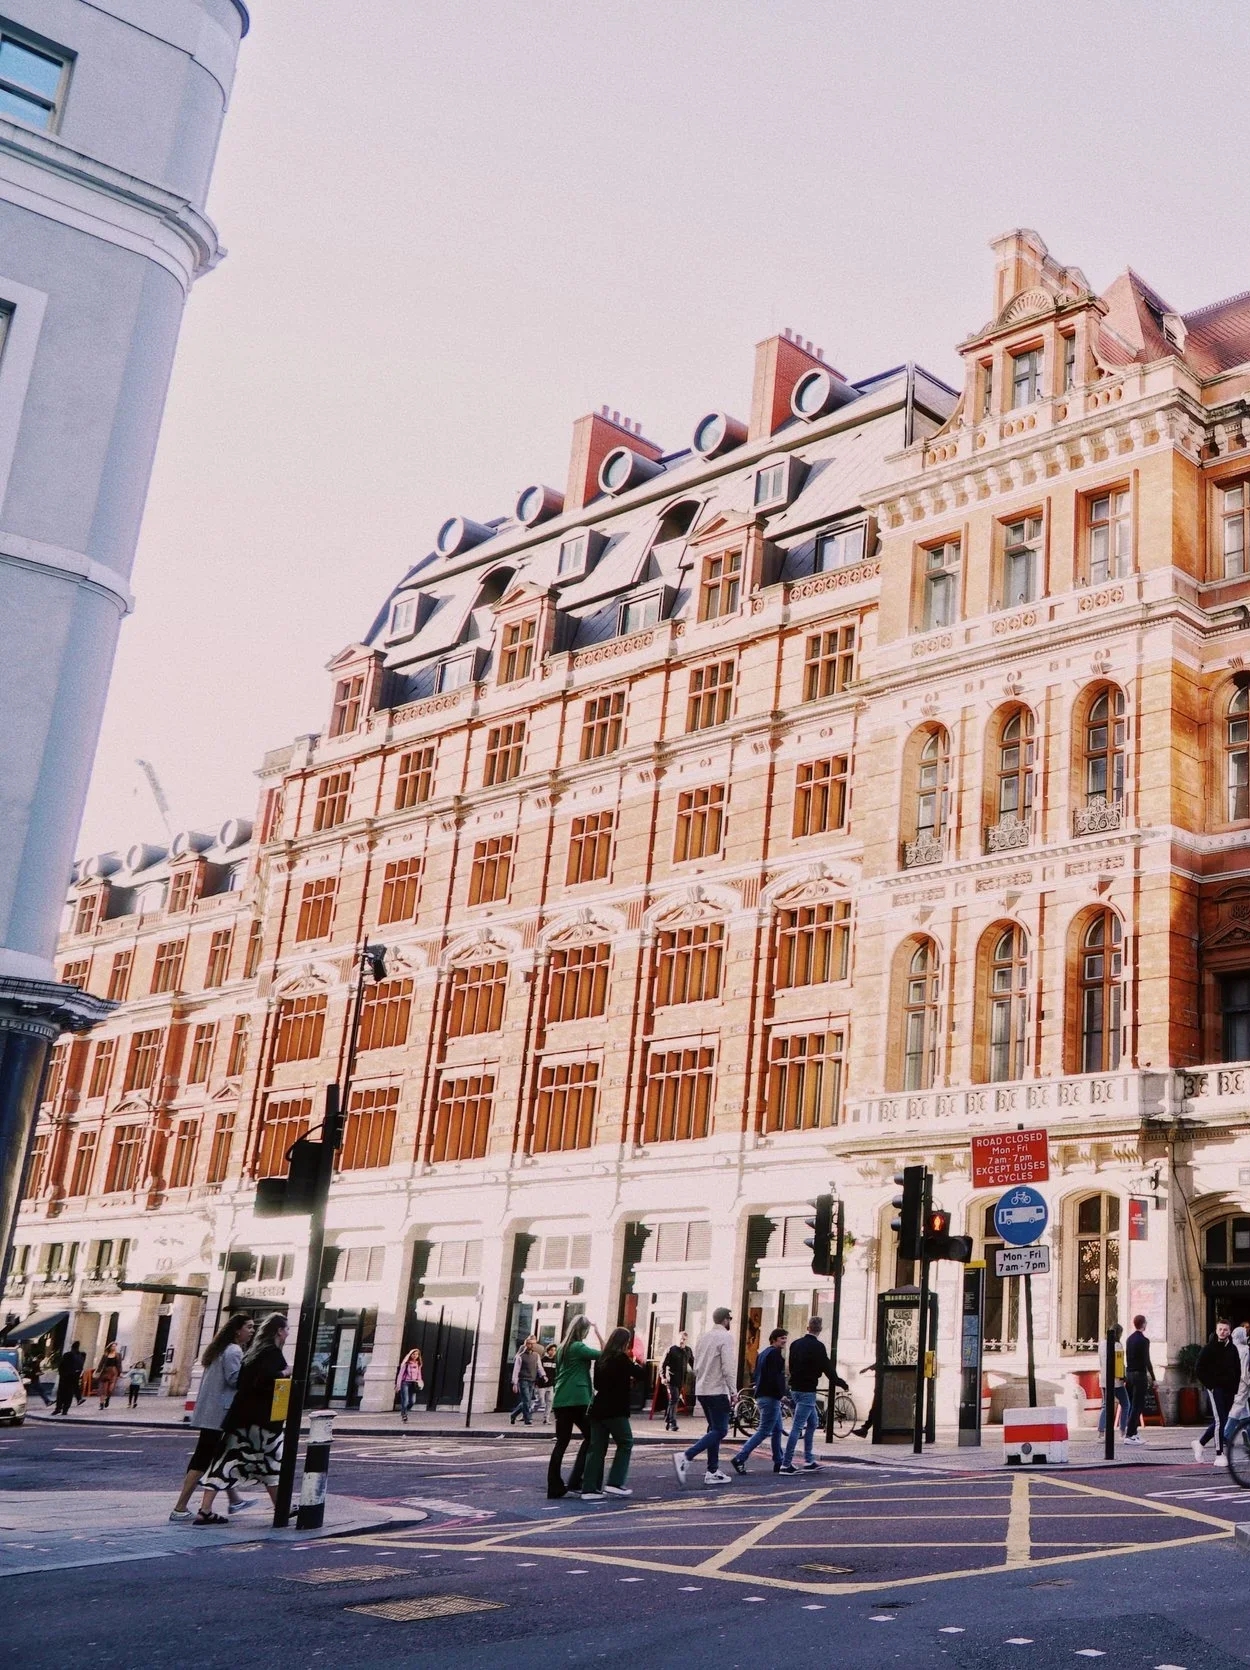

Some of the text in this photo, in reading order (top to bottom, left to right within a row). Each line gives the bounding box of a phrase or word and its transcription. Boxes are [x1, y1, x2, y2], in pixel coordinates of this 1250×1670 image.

[976, 1132, 1043, 1147] ROAD CLOSED
[992, 1147, 1011, 1155] Mon
[1017, 1144, 1028, 1153] Fri
[976, 1161, 1046, 1175] EXCEPT BUSES
[988, 1172, 1033, 1184] & CYCLES
[1003, 1252, 1022, 1261] Mon
[1029, 1250, 1041, 1259] Fri
